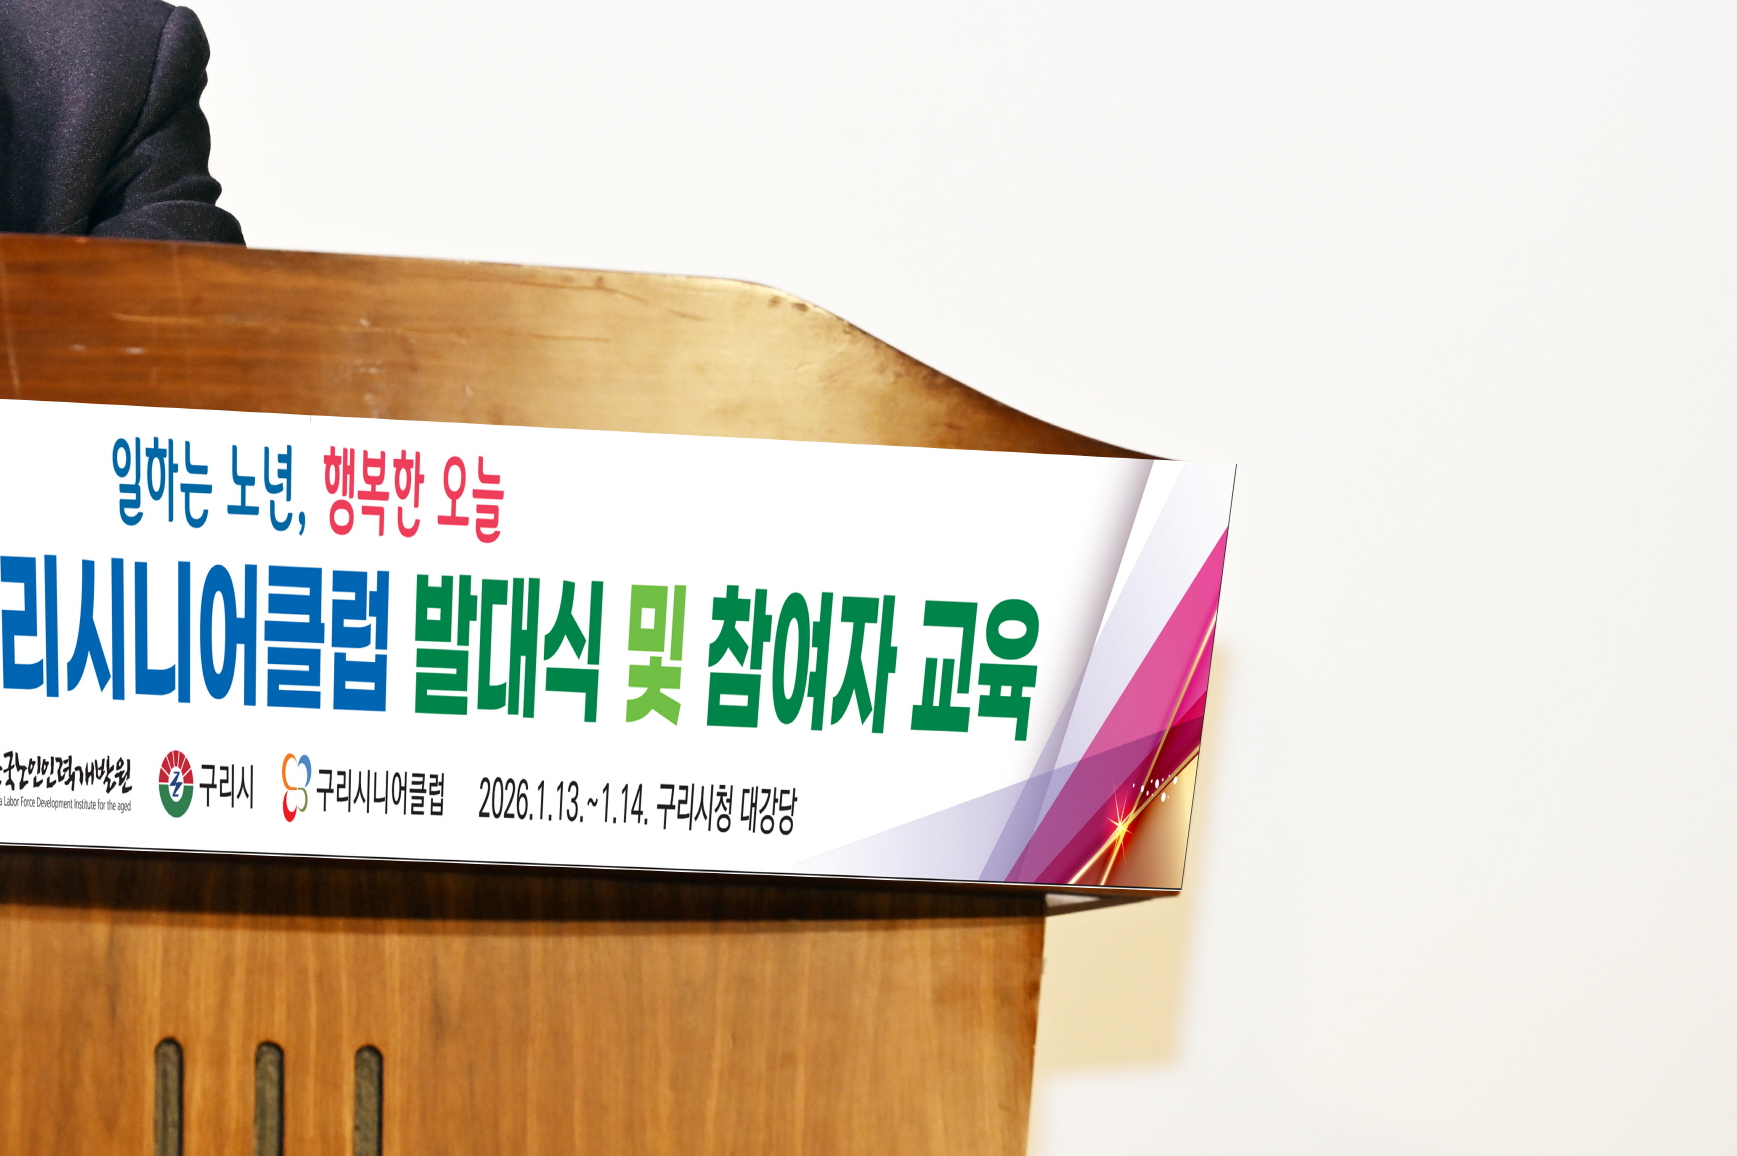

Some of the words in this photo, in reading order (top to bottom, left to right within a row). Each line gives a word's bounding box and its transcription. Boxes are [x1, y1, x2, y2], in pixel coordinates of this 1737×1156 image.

[111, 436, 213, 529] 일하는
[226, 444, 306, 537] 노년,
[323, 445, 425, 538] 행복한
[437, 455, 505, 544] 오늘
[414, 573, 605, 723] 발대식
[625, 584, 687, 726] 및
[706, 584, 899, 734] 참여자
[910, 598, 1040, 742] 교육
[3, 795, 19, 807] Labor
[20, 796, 35, 807] Force
[36, 796, 73, 810] Development
[74, 798, 96, 810] Institute
[97, 799, 106, 810] for
[106, 799, 116, 811] the
[117, 800, 131, 813] aged
[199, 763, 254, 810] 구리시
[316, 768, 445, 817] 구리시니어클럽
[478, 776, 648, 826] 2026.1.13.~1.14.
[656, 783, 733, 833] 구리시청
[740, 785, 798, 836] 대강당
